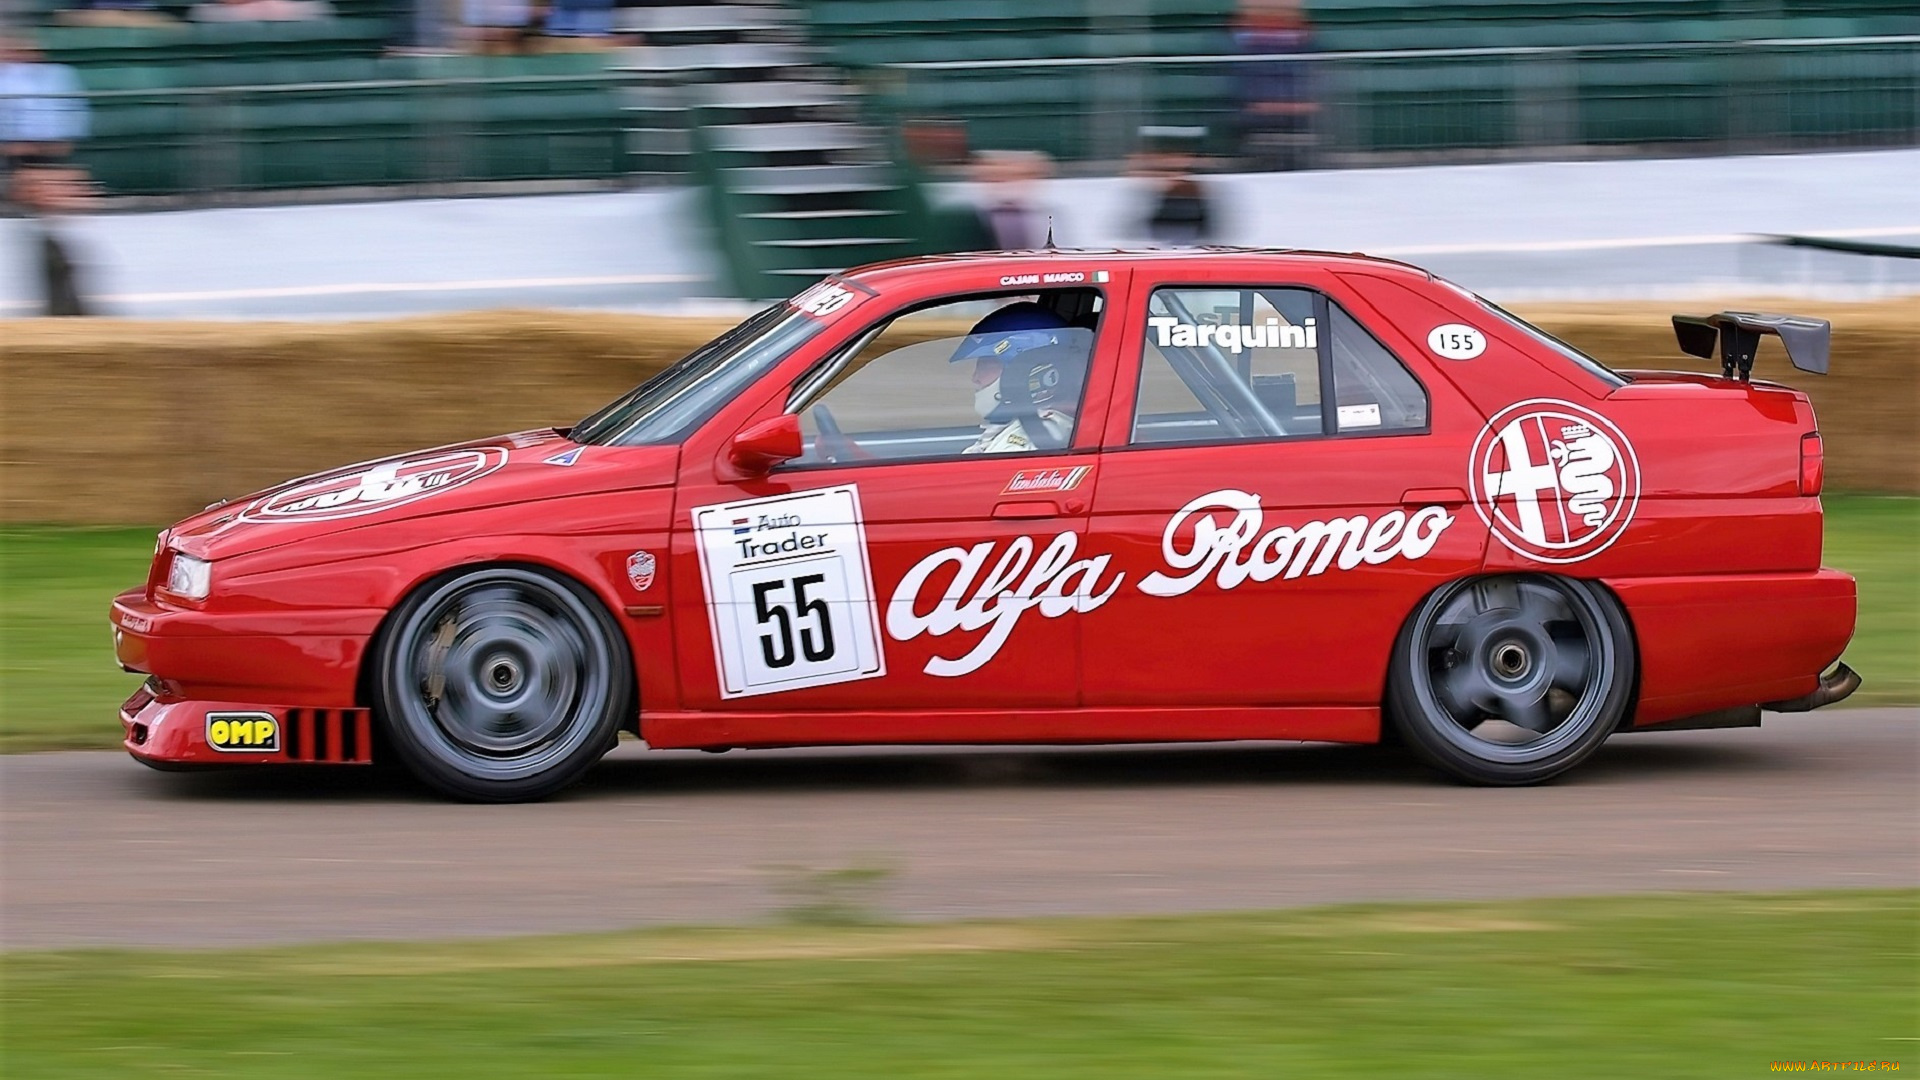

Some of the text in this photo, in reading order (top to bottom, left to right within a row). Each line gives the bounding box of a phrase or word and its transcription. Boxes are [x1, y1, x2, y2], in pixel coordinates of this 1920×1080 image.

[1043, 272, 1084, 283] MARCO
[1148, 317, 1318, 354] Tarquini
[1440, 333, 1473, 350] 155
[757, 513, 801, 532] Auto
[734, 532, 829, 559] Trader
[886, 489, 1456, 678] Alfa Romeo
[752, 573, 835, 669] 55
[211, 720, 275, 746] OMP
